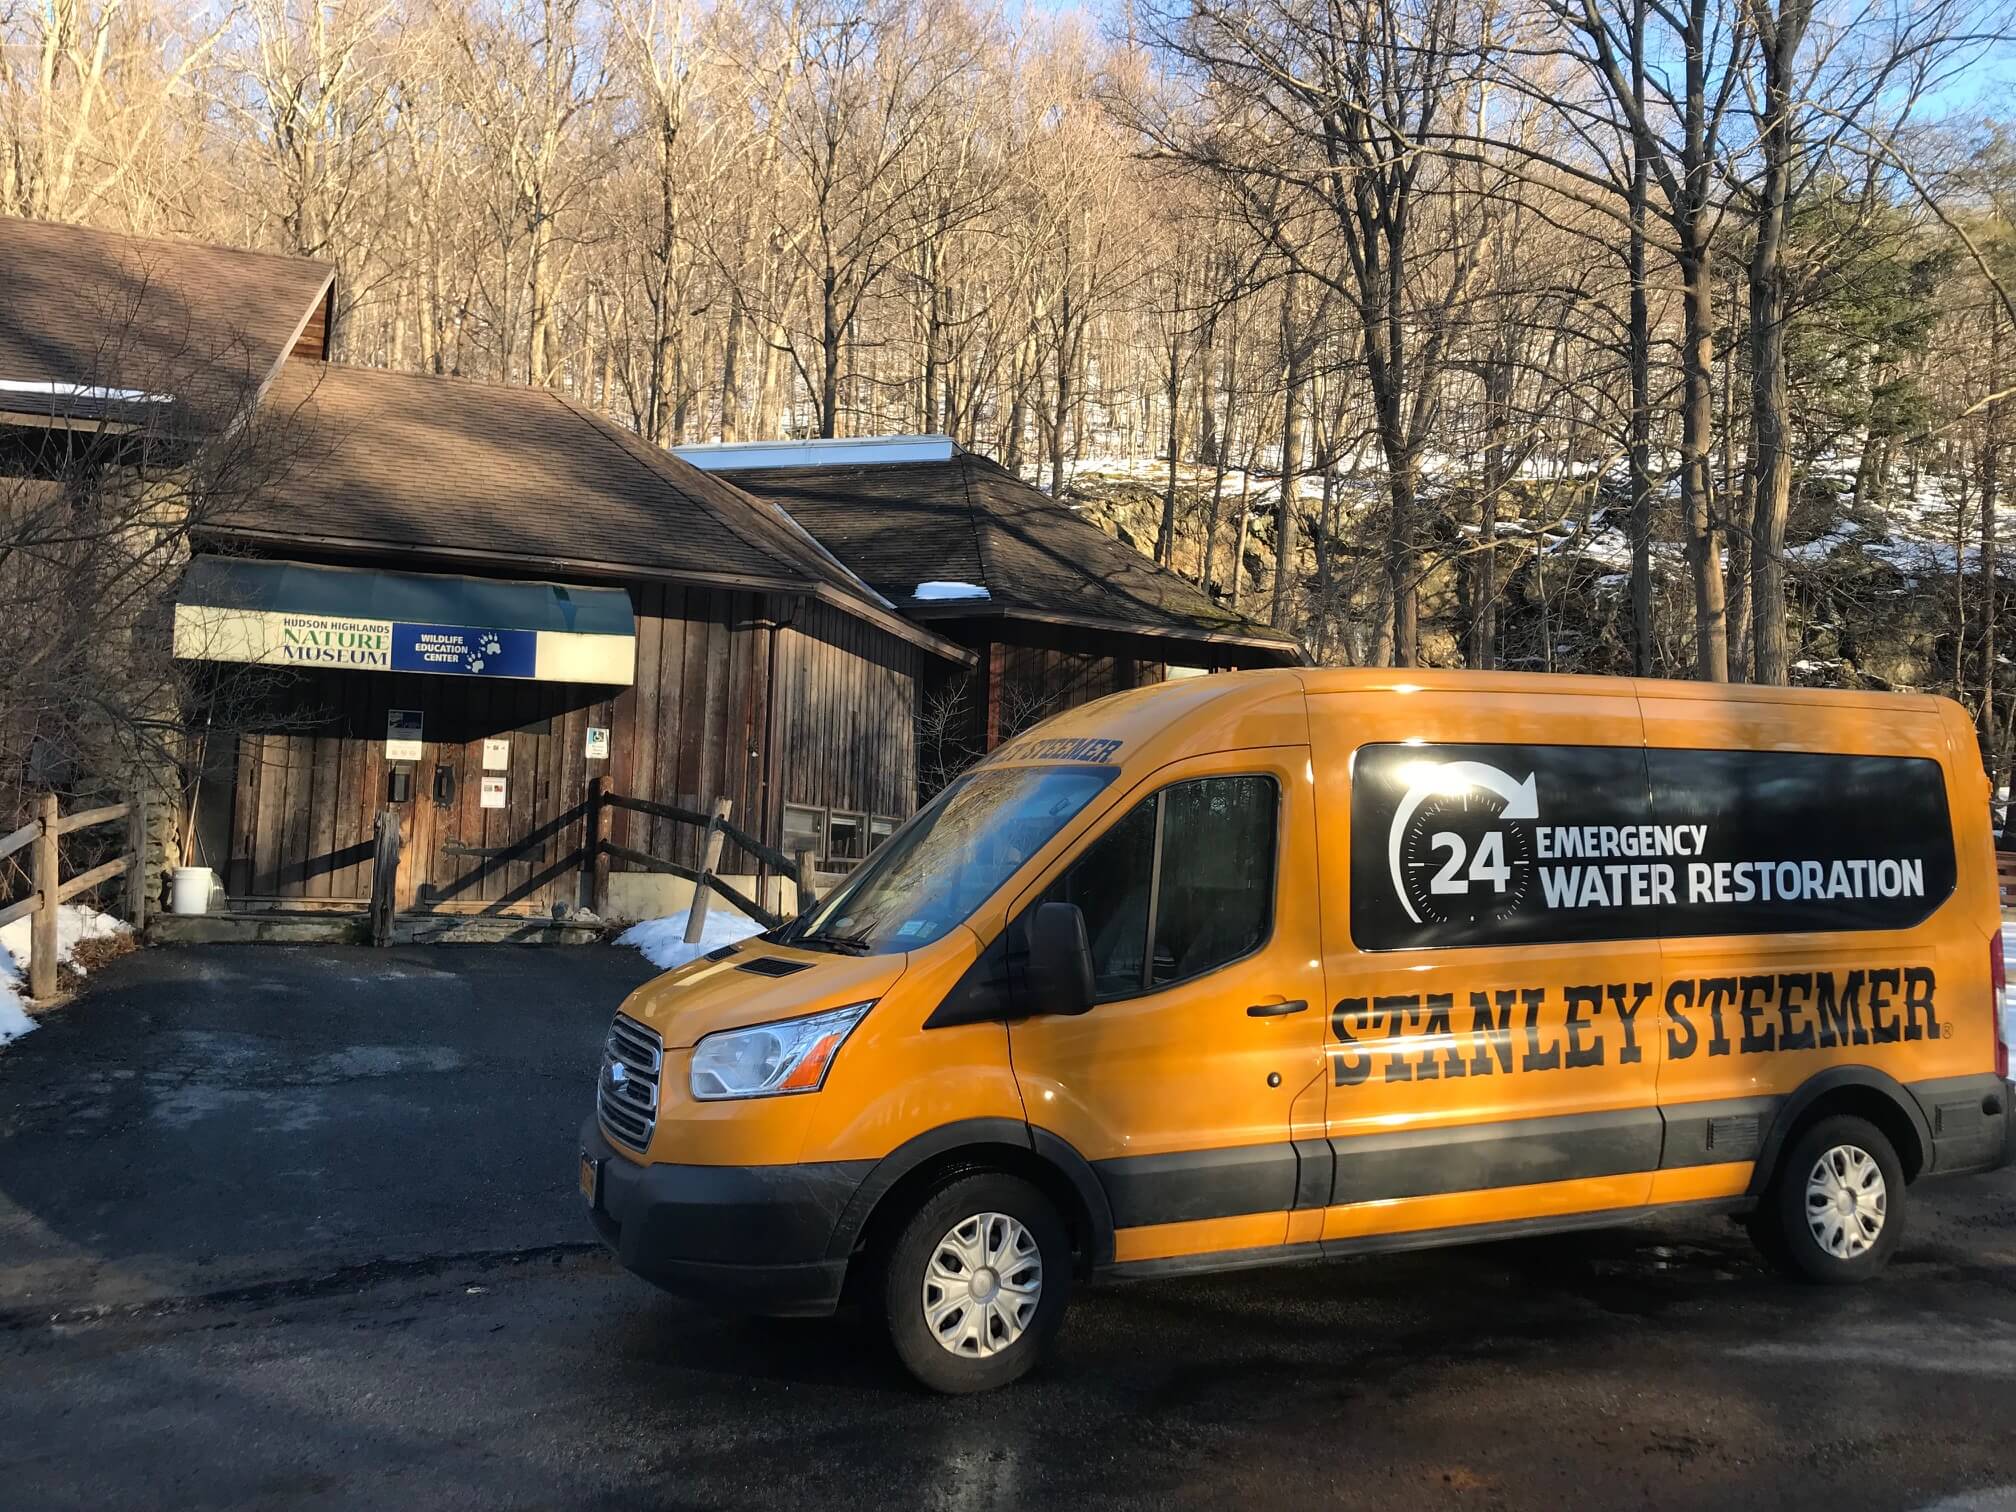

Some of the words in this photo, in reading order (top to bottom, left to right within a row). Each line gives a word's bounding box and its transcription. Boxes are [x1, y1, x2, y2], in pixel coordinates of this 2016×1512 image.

[284, 618, 327, 629] HUDSON
[331, 622, 389, 633] HIGHLANDS
[284, 628, 389, 649] NATURE
[415, 643, 468, 654] EDUCATION
[421, 634, 463, 644] WILDLIFE
[283, 645, 387, 664] MUSEUM
[424, 653, 459, 663] CENTER
[1536, 825, 1707, 858] EMERGENCY
[1430, 831, 1511, 895] 24
[1538, 864, 1677, 908] WATER
[1688, 859, 1925, 904] RESTORATION
[1331, 982, 1653, 1087] STANLEY
[1664, 966, 1941, 1060] STEEMER
